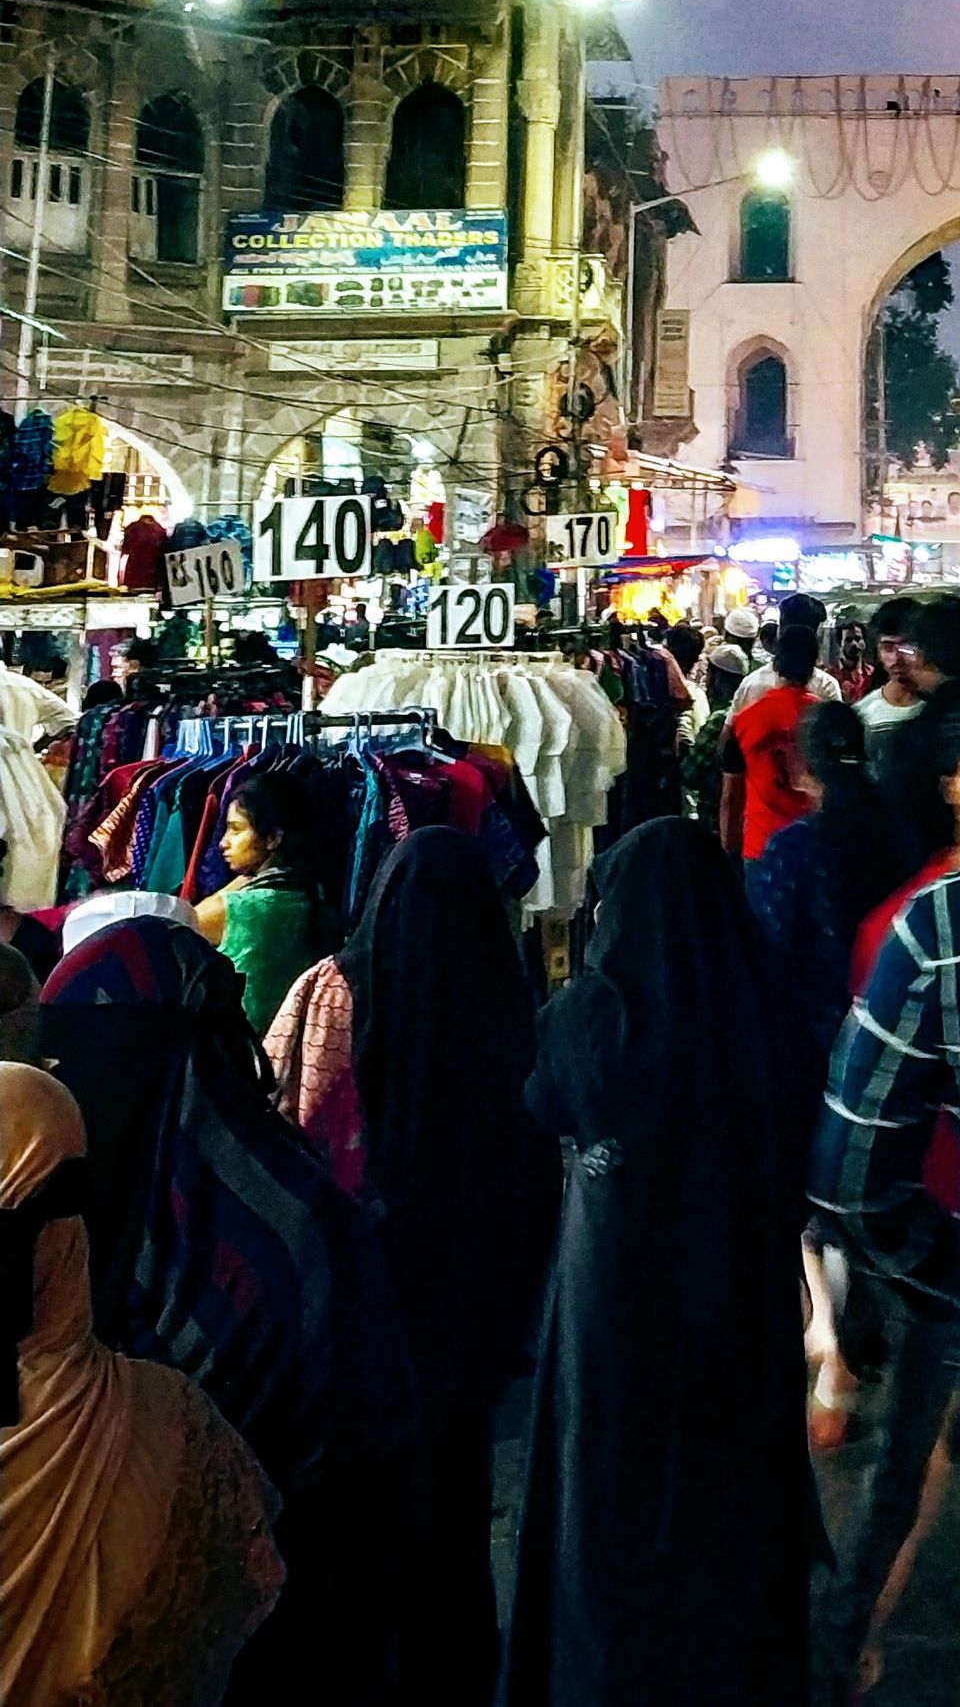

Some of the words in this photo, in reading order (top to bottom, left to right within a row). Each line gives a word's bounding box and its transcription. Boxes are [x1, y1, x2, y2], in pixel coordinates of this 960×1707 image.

[231, 232, 383, 249] COLLECTION
[390, 230, 499, 247] TRADERS
[259, 498, 367, 576] 140
[564, 515, 610, 559] 170
[195, 550, 235, 598] 160
[431, 587, 510, 645] 120
